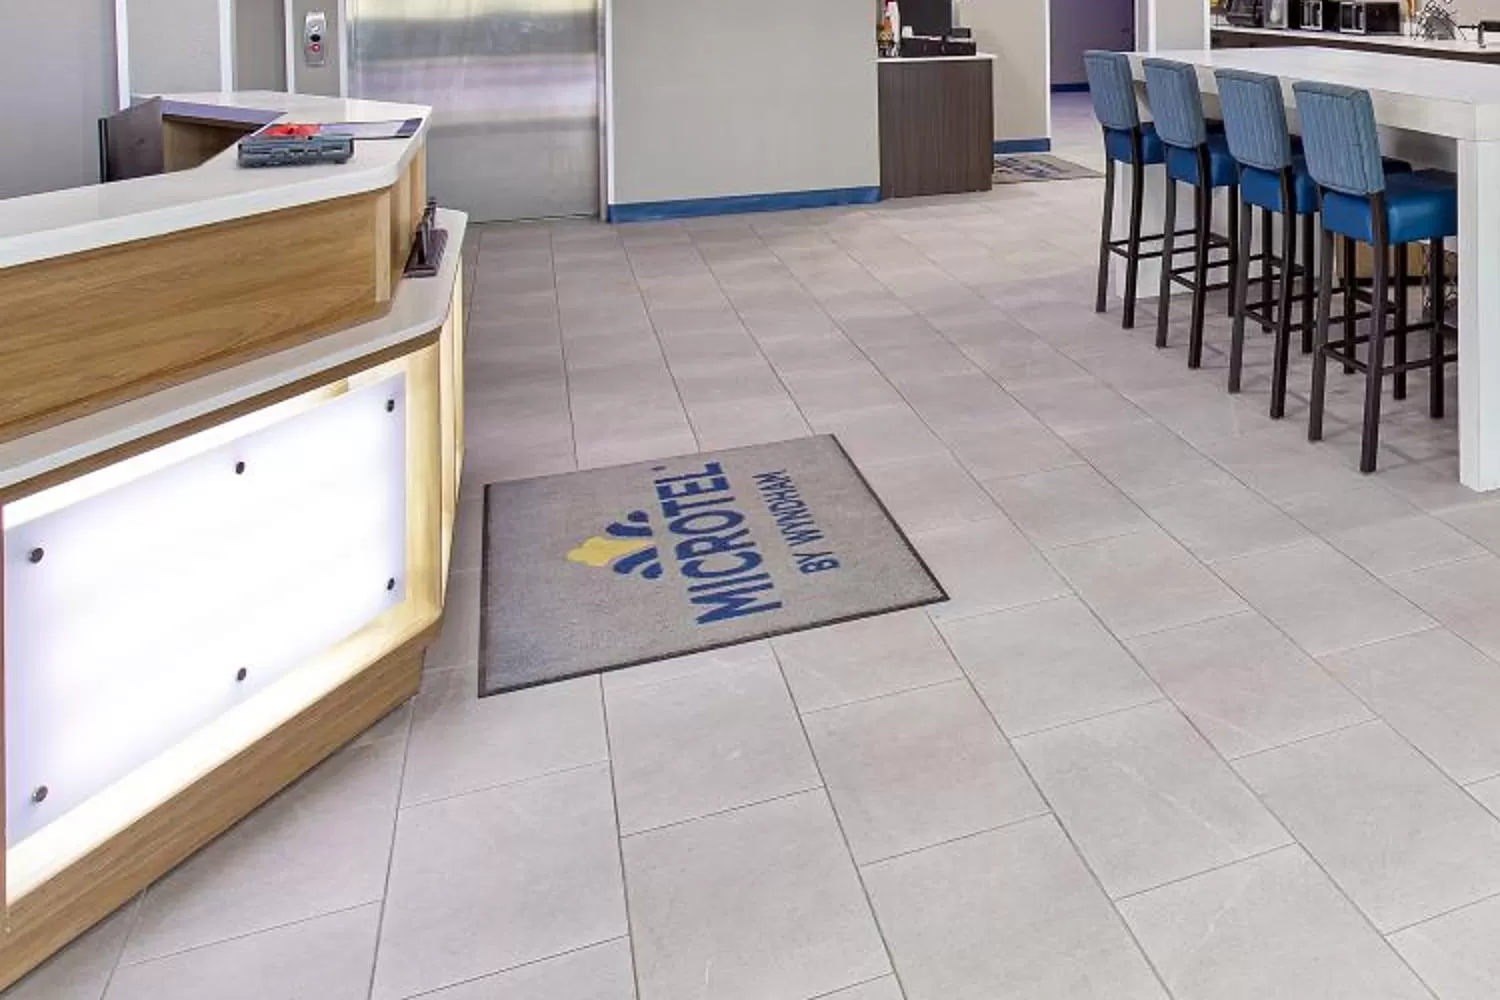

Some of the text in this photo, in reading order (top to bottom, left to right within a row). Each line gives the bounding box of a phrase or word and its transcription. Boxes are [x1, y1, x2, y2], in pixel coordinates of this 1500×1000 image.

[654, 461, 783, 625] MICROTEL
[752, 468, 841, 575] BY WYNDHAM
